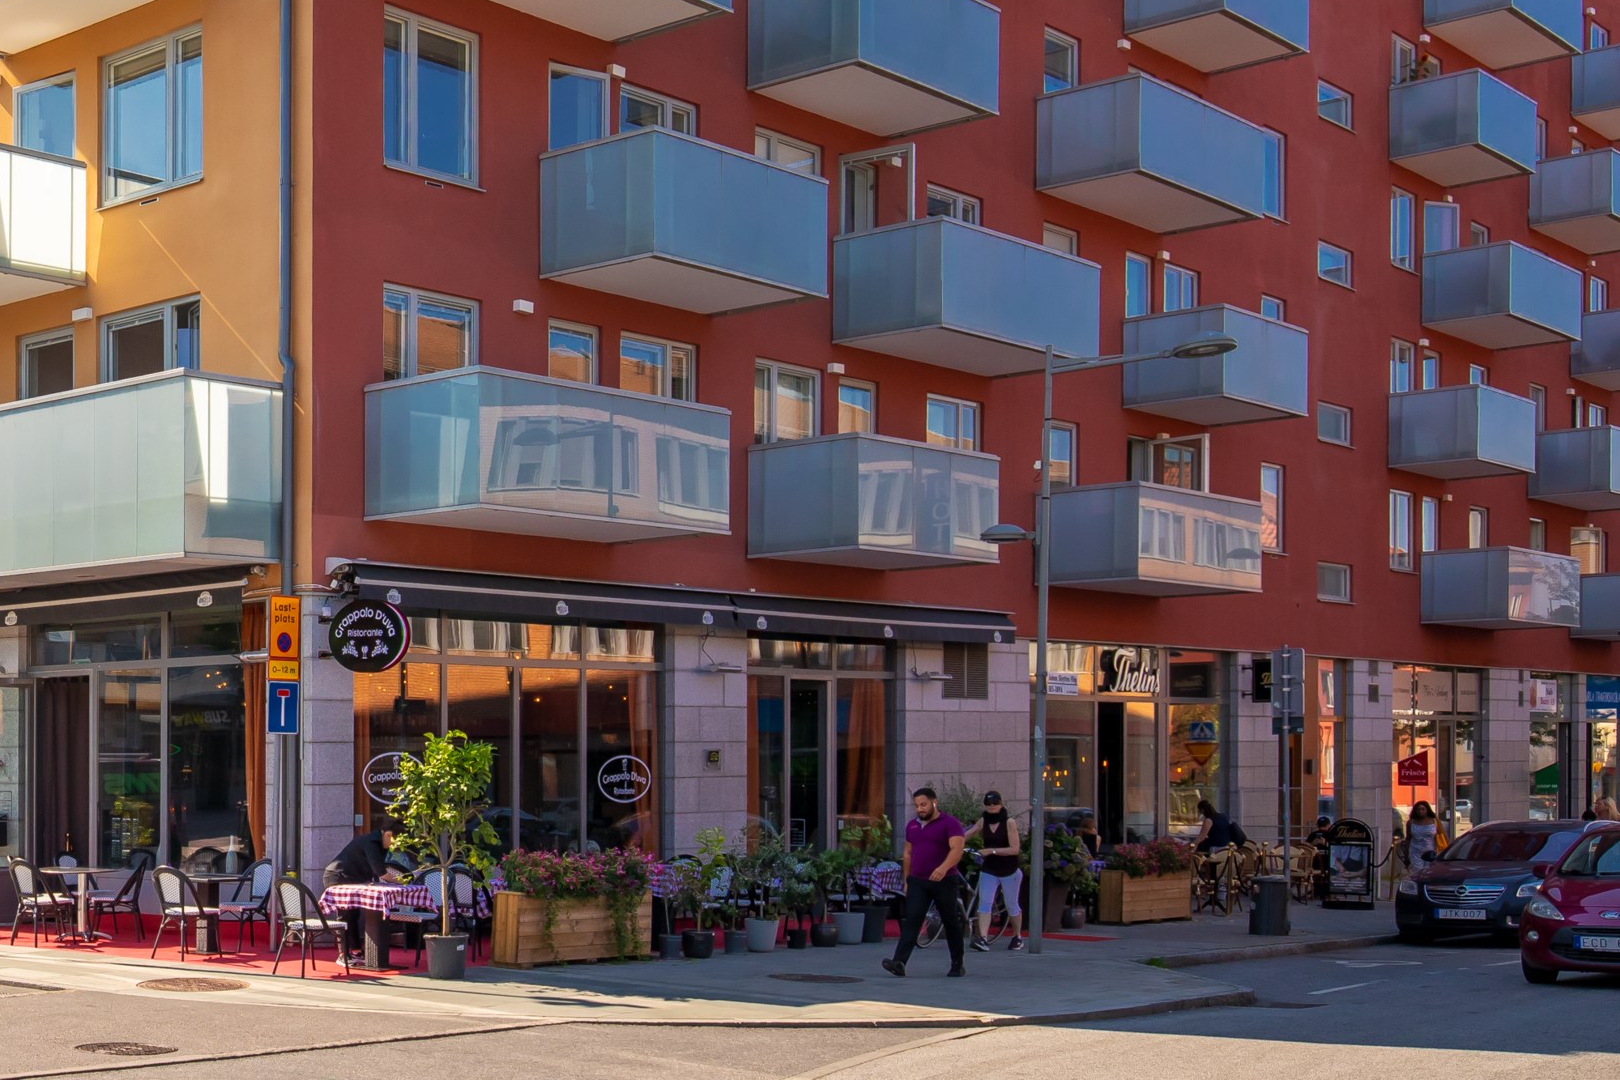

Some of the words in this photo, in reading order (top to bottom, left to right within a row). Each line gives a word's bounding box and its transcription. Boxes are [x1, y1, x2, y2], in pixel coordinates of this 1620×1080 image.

[275, 603, 296, 611] Last-
[275, 614, 295, 624] plats
[335, 606, 374, 638] Grappolo
[375, 610, 396, 637] D'uva
[347, 629, 383, 637] Ristorante
[272, 666, 288, 674] 0-12
[1110, 648, 1160, 693] Thelins
[368, 769, 402, 783] Grappolo
[1582, 938, 1608, 948] ECD
